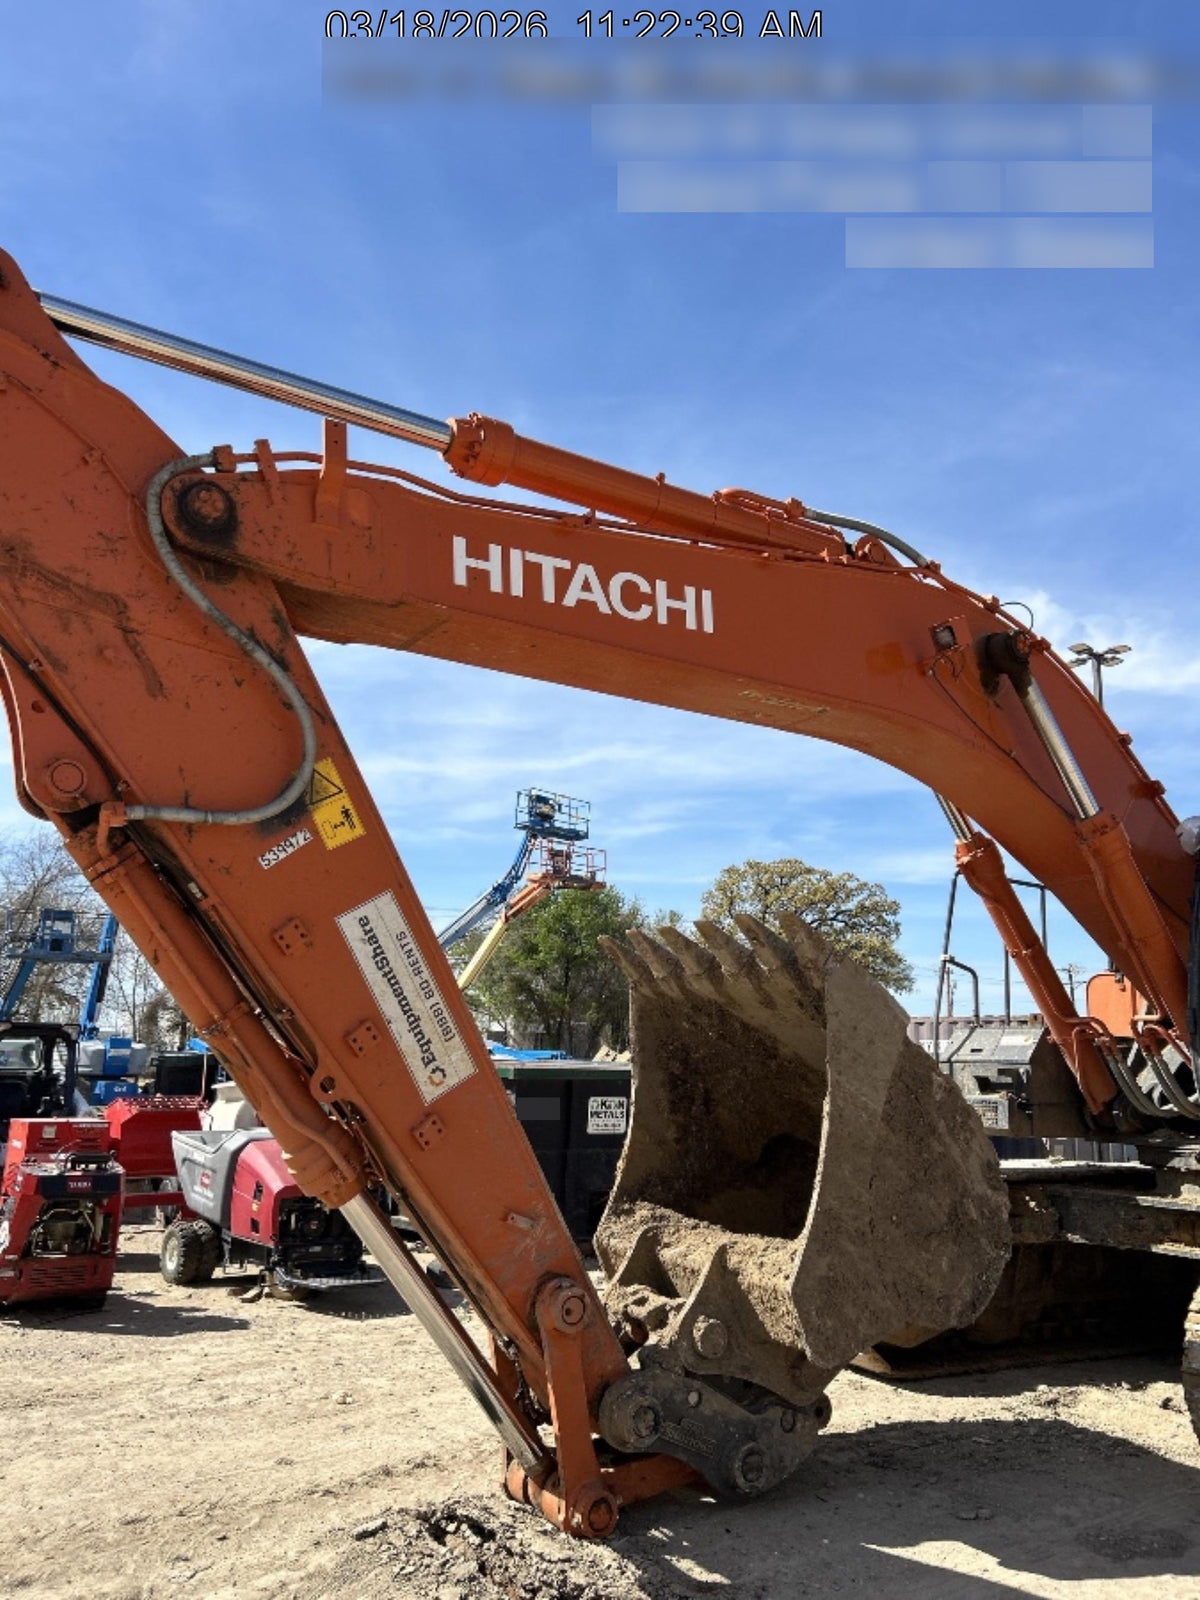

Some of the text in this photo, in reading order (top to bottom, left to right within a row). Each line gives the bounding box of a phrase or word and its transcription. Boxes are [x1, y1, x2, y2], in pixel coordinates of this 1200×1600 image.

[453, 535, 714, 634] HITACHI
[358, 915, 437, 1068] EquipmentShare
[395, 930, 456, 1043] (888) 80-RENTS
